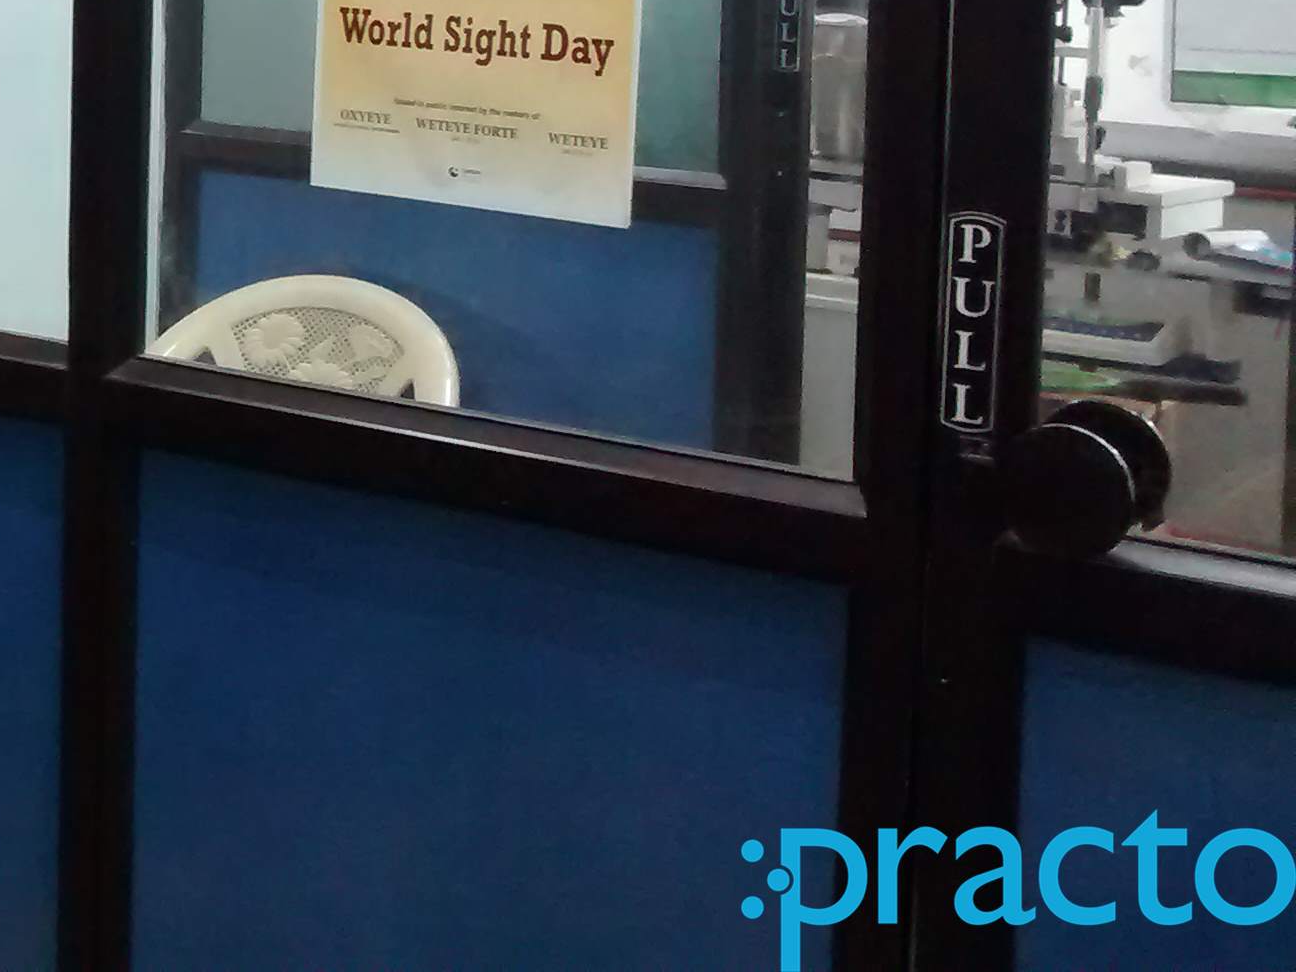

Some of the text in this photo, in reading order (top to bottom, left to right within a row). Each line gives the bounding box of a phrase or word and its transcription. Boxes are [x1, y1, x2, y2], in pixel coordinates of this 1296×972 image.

[339, 6, 615, 77] World Sight Day
[339, 109, 392, 125] OXYEYE
[415, 117, 472, 135] WETEYE
[474, 123, 520, 140] FORTE
[548, 132, 609, 150] WETEYE
[951, 223, 996, 425] PULL
